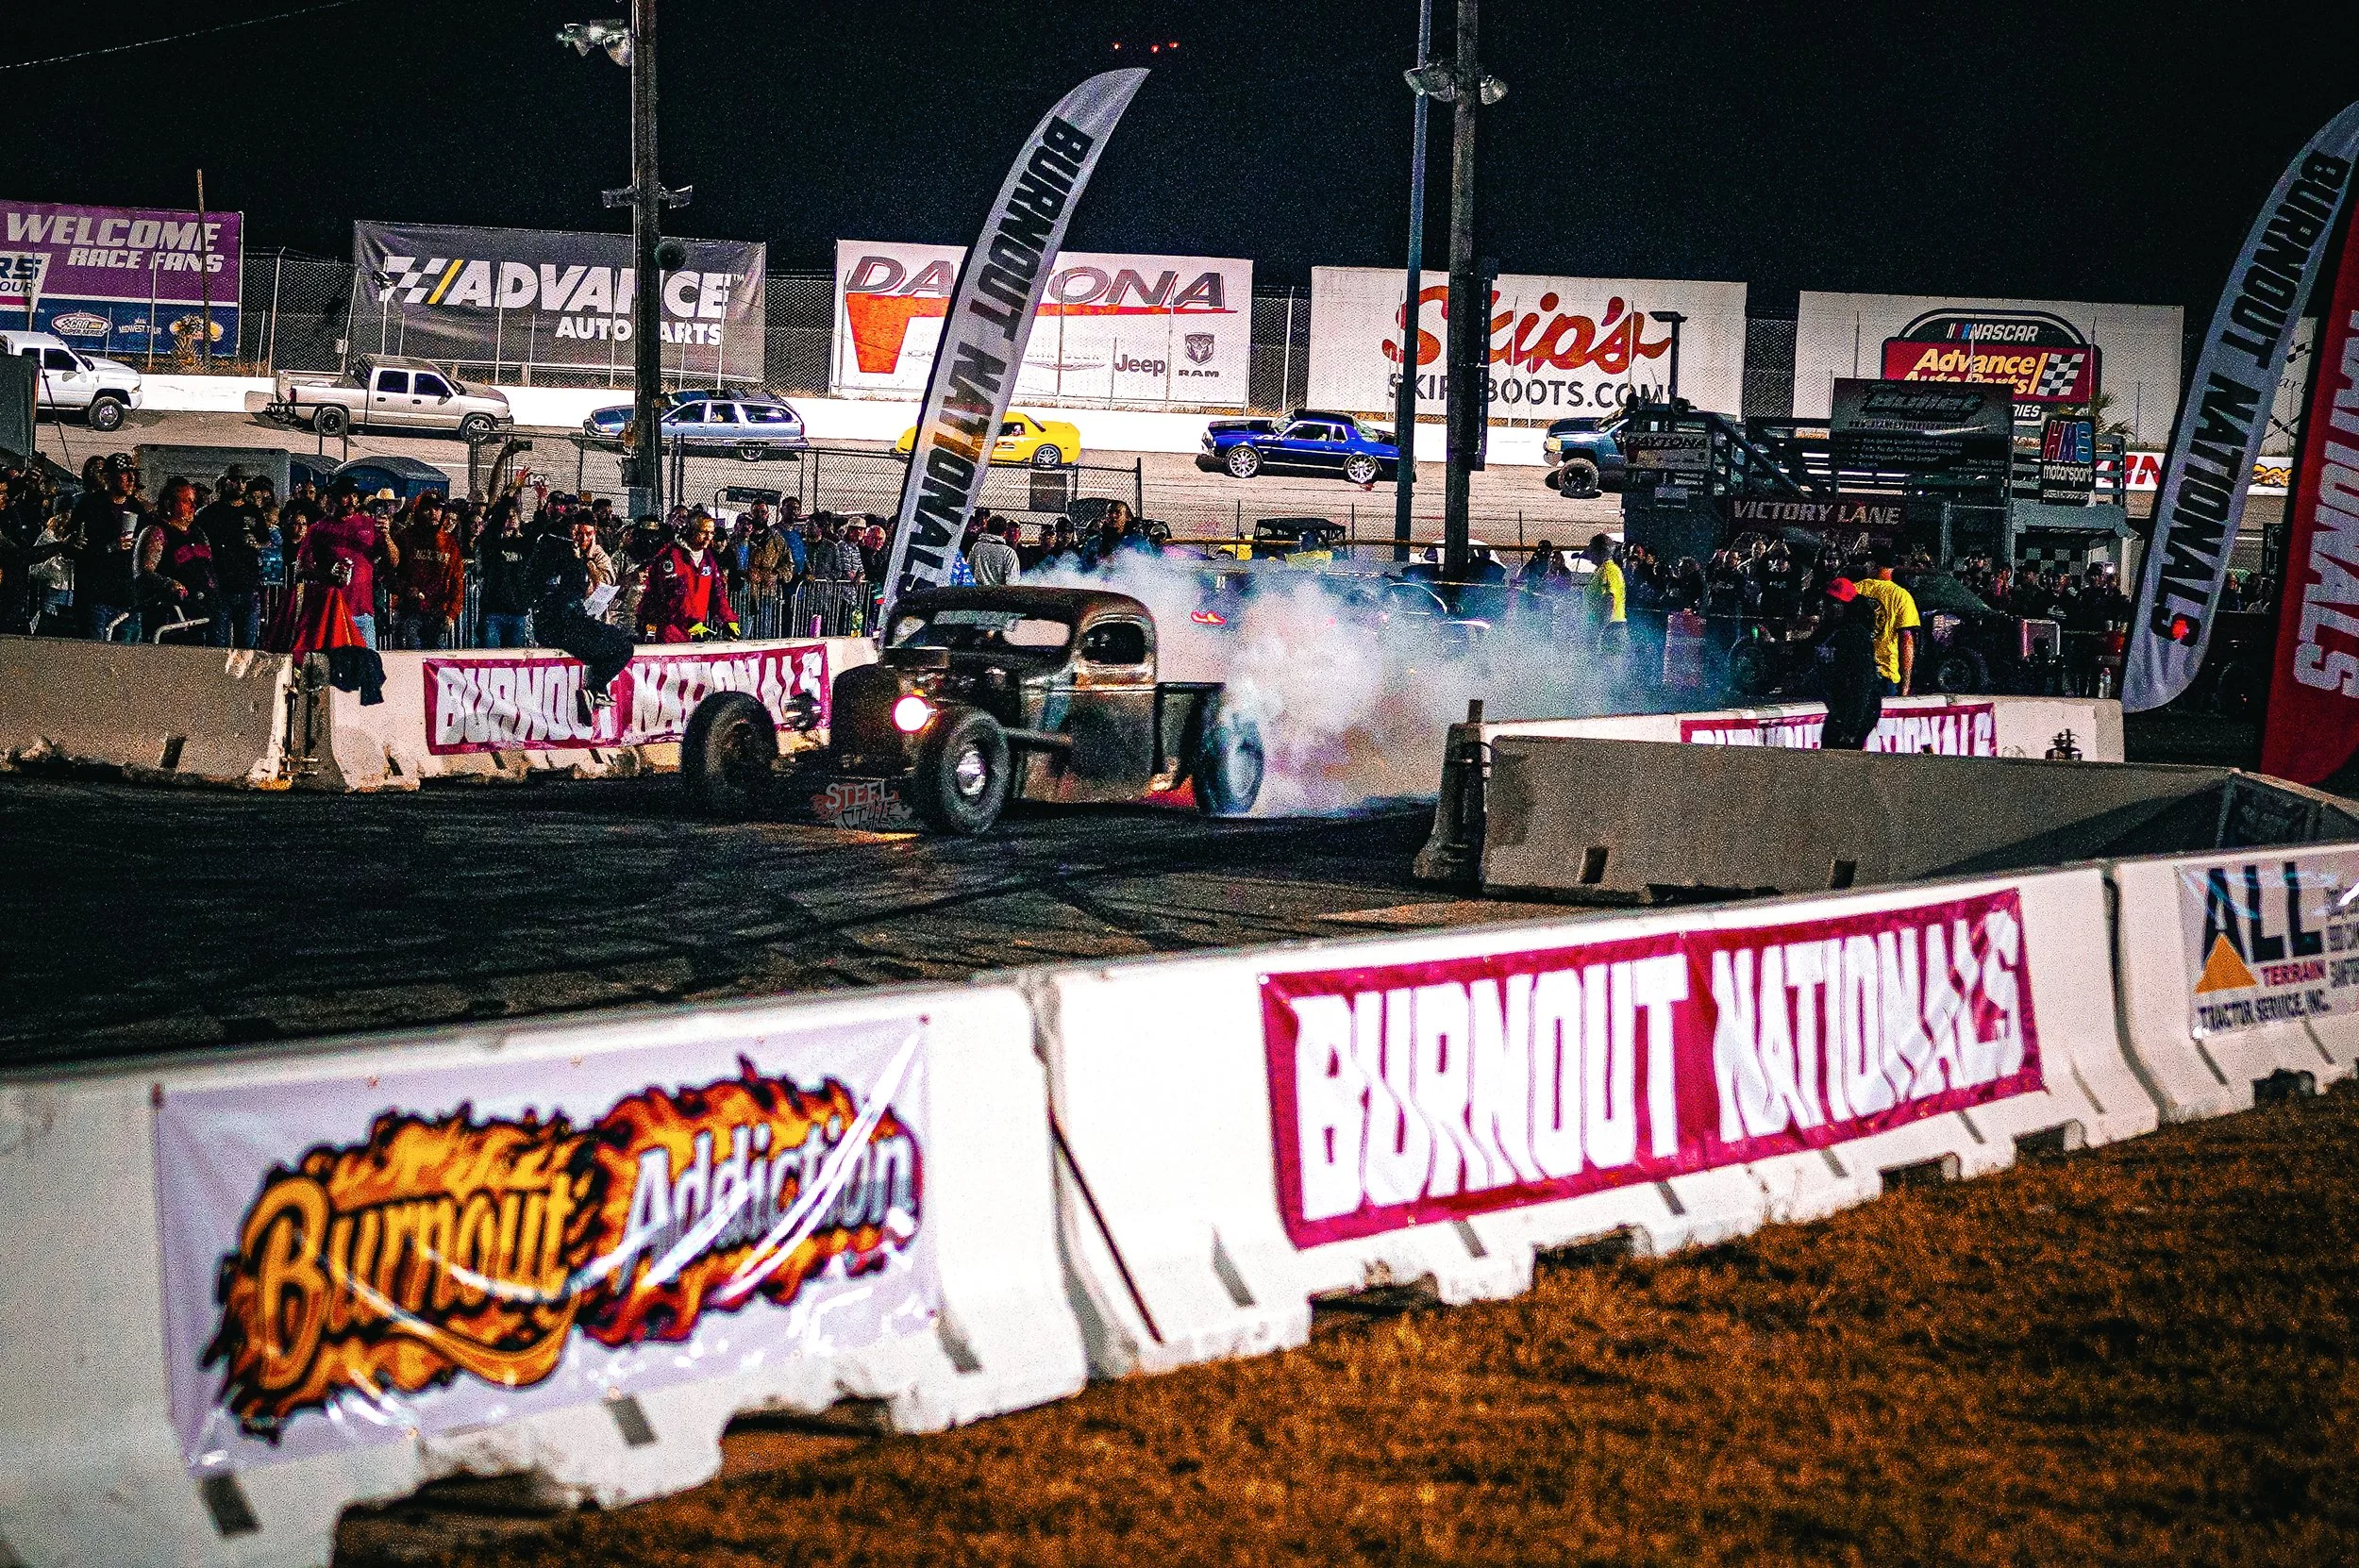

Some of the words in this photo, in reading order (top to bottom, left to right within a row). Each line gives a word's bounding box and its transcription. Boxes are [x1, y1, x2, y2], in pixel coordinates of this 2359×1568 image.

[7, 213, 222, 252] WELCOME
[969, 114, 1096, 342] BURNOUT
[67, 247, 143, 270] RACE
[148, 252, 225, 274] FANS
[2220, 148, 2352, 361] BURNOUT
[850, 256, 1225, 308] DAONA
[555, 317, 633, 342] AUTO
[660, 322, 721, 346] ARTS
[1970, 323, 2040, 342] NASCAR
[1115, 354, 1166, 376] Jeep
[1178, 369, 1220, 378] RAM
[1914, 348, 2036, 375] Advance
[2043, 462, 2094, 488] motorsport
[1734, 500, 1833, 523] VICTORY
[1837, 506, 1901, 525] LANE
[2201, 860, 2324, 971] ALL
[2261, 959, 2327, 988] TERRAIN
[1291, 953, 1690, 1222] BURNOUT
[1712, 909, 2023, 1143] NATIONALS
[241, 1172, 576, 1391] Burnout
[618, 1111, 917, 1292] Addiction
